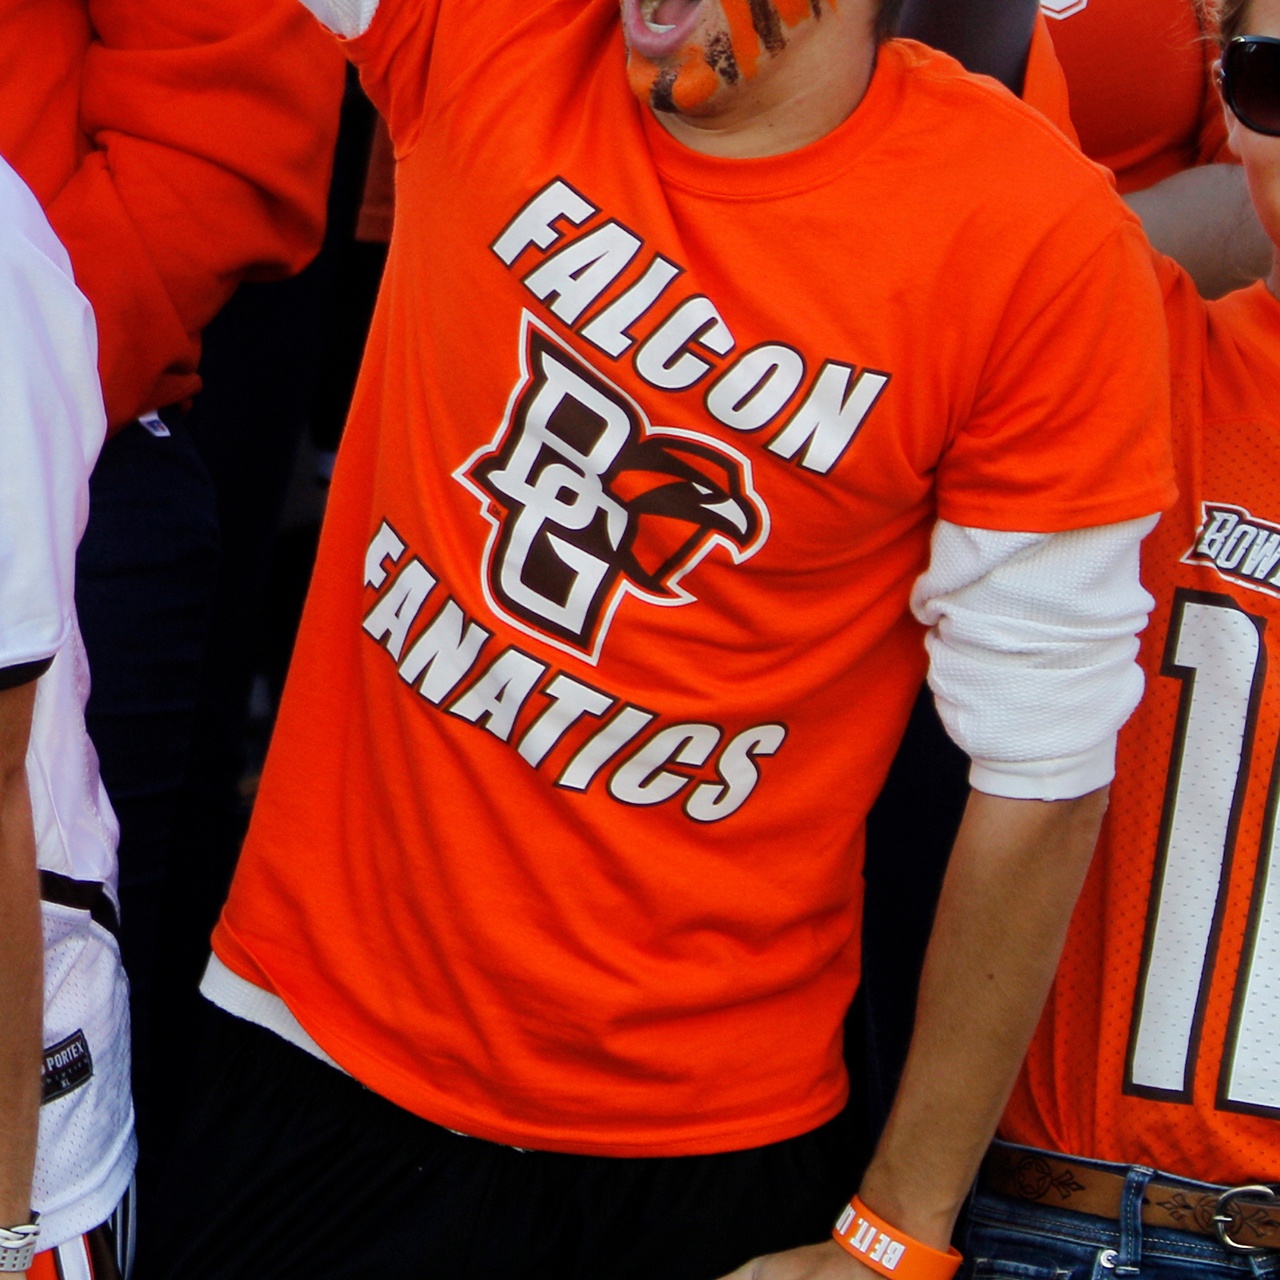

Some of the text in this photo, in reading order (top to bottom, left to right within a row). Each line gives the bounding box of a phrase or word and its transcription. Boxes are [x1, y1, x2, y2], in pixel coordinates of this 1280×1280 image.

[487, 175, 892, 478] FALCON
[361, 517, 789, 822] FANATICS
[849, 1217, 878, 1254] IT.
[869, 1233, 906, 1270] BE
